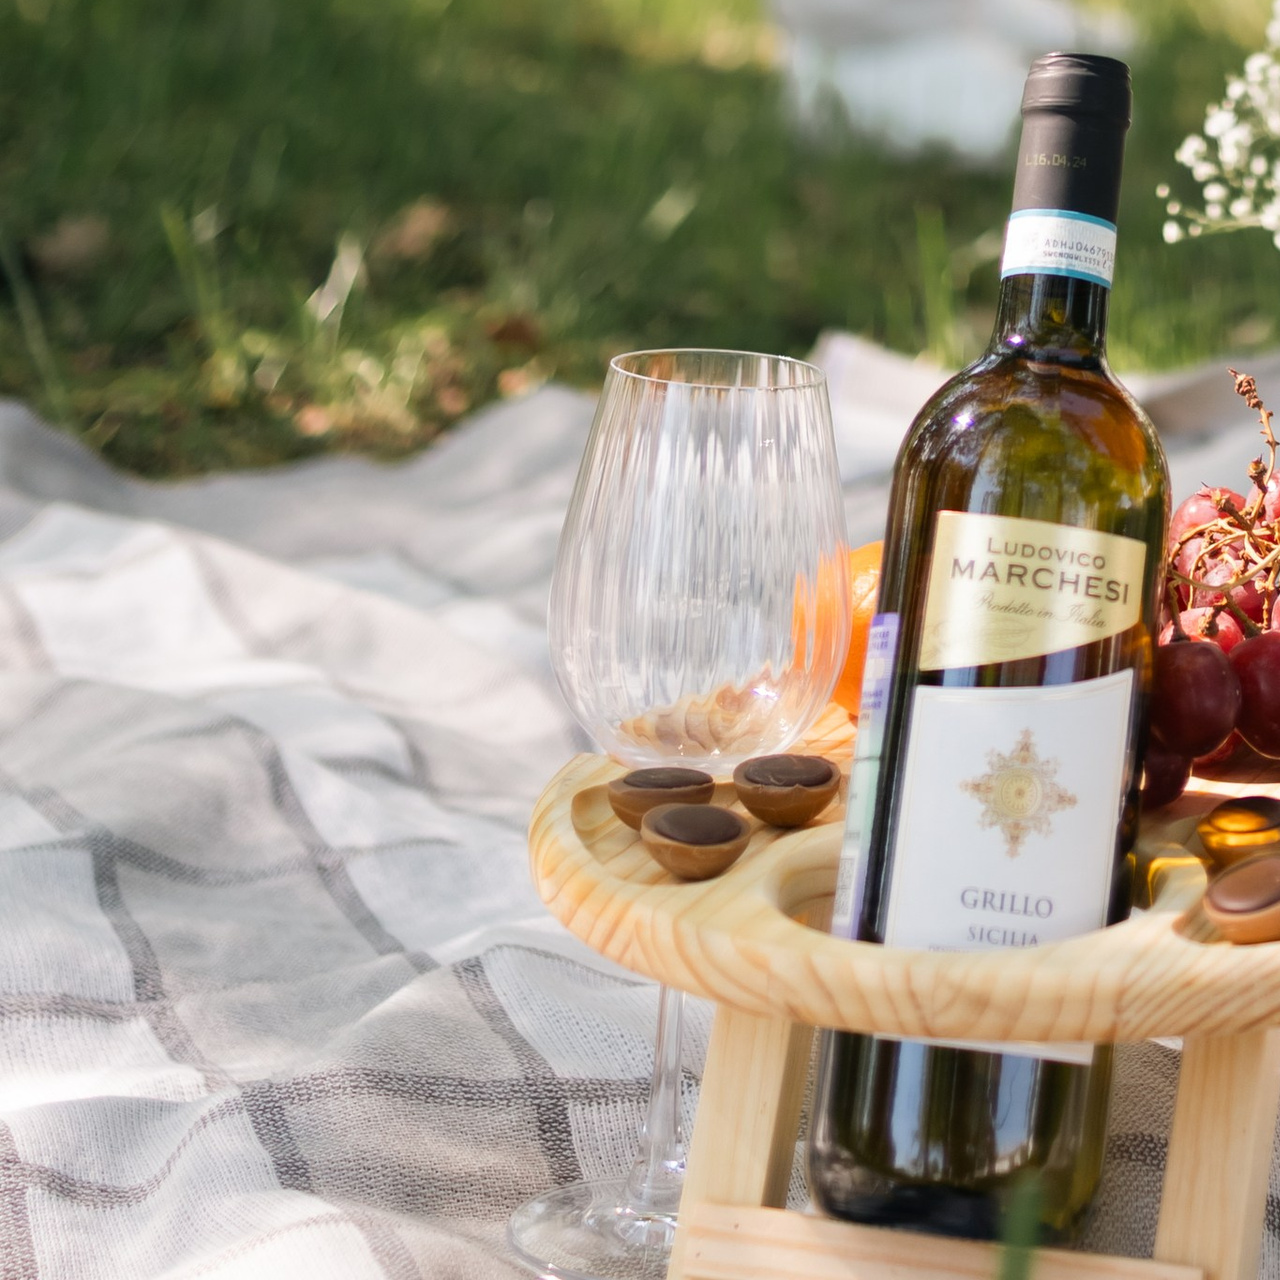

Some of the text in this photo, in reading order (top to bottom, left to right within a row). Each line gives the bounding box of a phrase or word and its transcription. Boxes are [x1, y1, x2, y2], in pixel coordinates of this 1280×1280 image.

[987, 537, 1106, 570] LUDOVICO
[950, 558, 1129, 605] MARCHESI
[974, 590, 1107, 630] Prodotto in Italia
[960, 888, 1054, 919] GRILLO
[967, 926, 1039, 947] SICILIA
